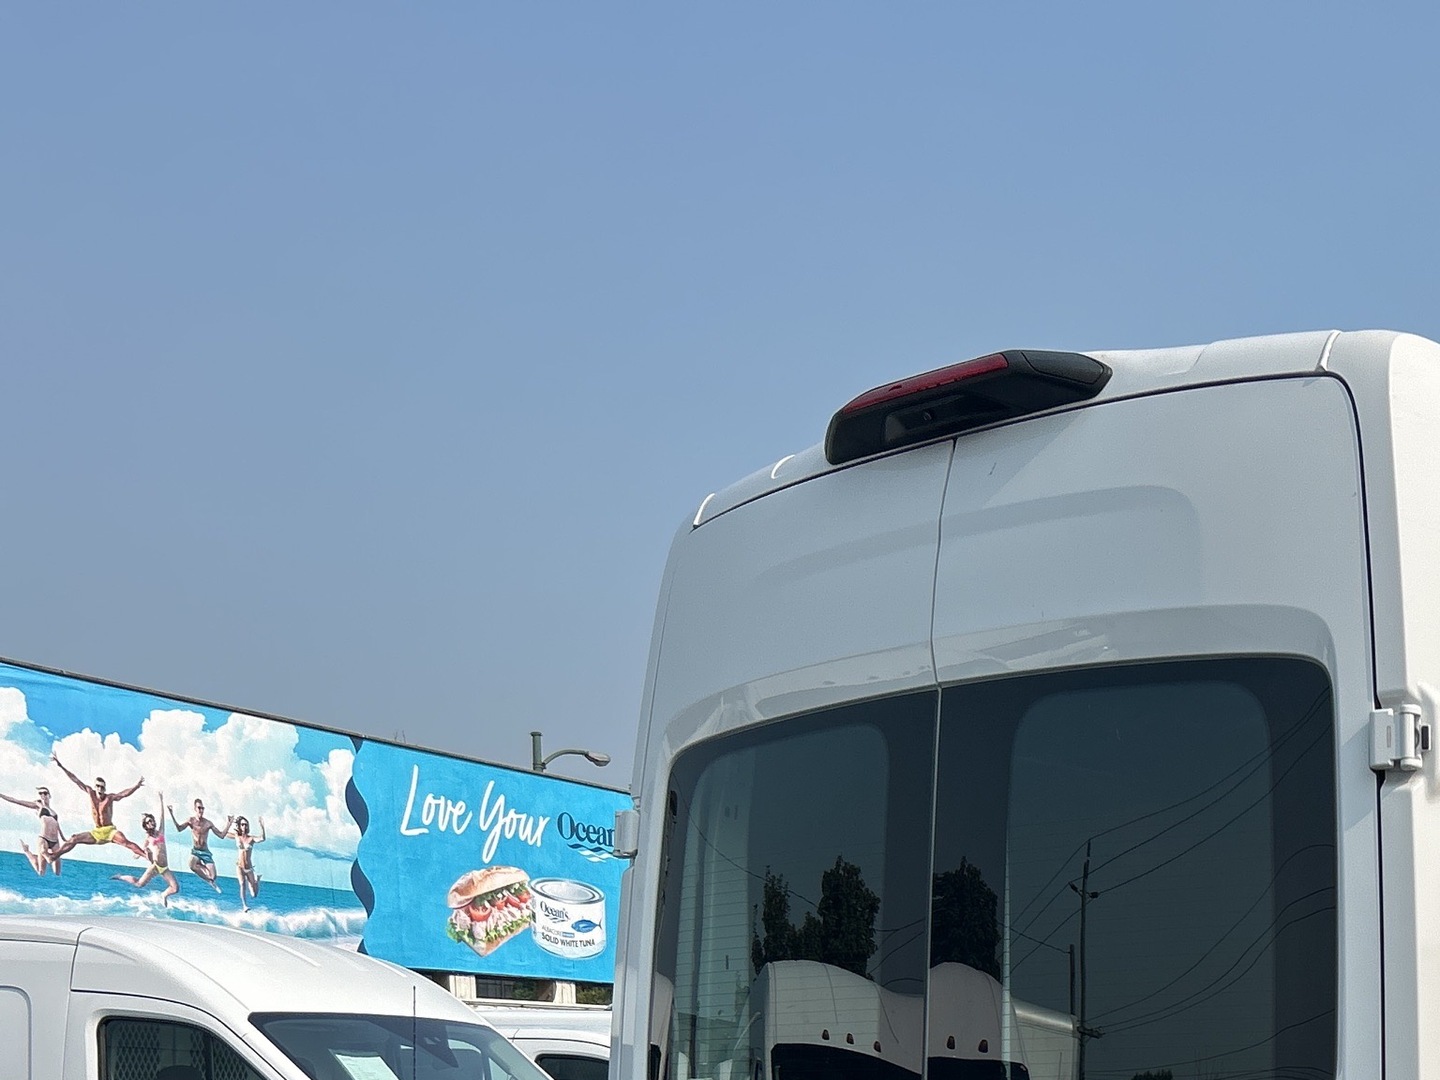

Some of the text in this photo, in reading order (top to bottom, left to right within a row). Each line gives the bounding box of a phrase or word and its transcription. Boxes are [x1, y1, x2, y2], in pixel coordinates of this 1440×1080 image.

[400, 764, 473, 836] Love
[479, 780, 550, 864] Your
[541, 932, 559, 944] SOLID
[560, 939, 579, 947] WHITE
